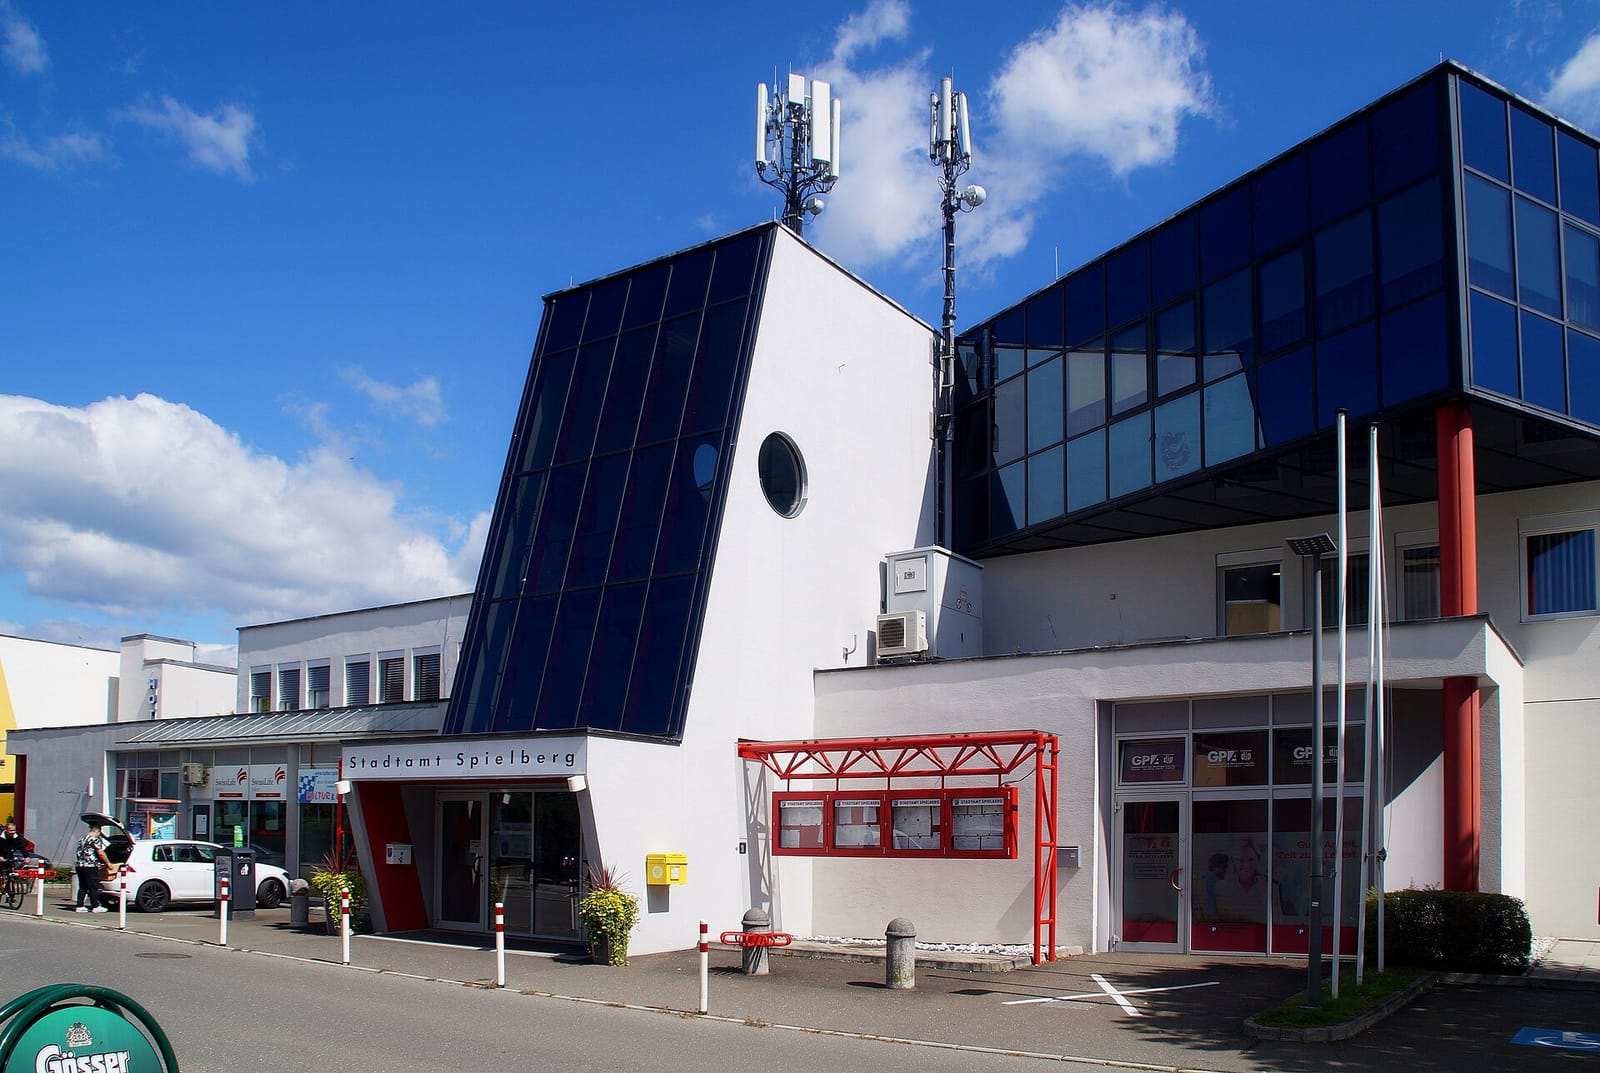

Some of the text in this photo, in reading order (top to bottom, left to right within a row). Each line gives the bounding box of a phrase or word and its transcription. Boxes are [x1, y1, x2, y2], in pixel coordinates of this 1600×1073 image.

[350, 749, 575, 769] Stadtamt Spielberg
[35, 1043, 131, 1073] Gösser
